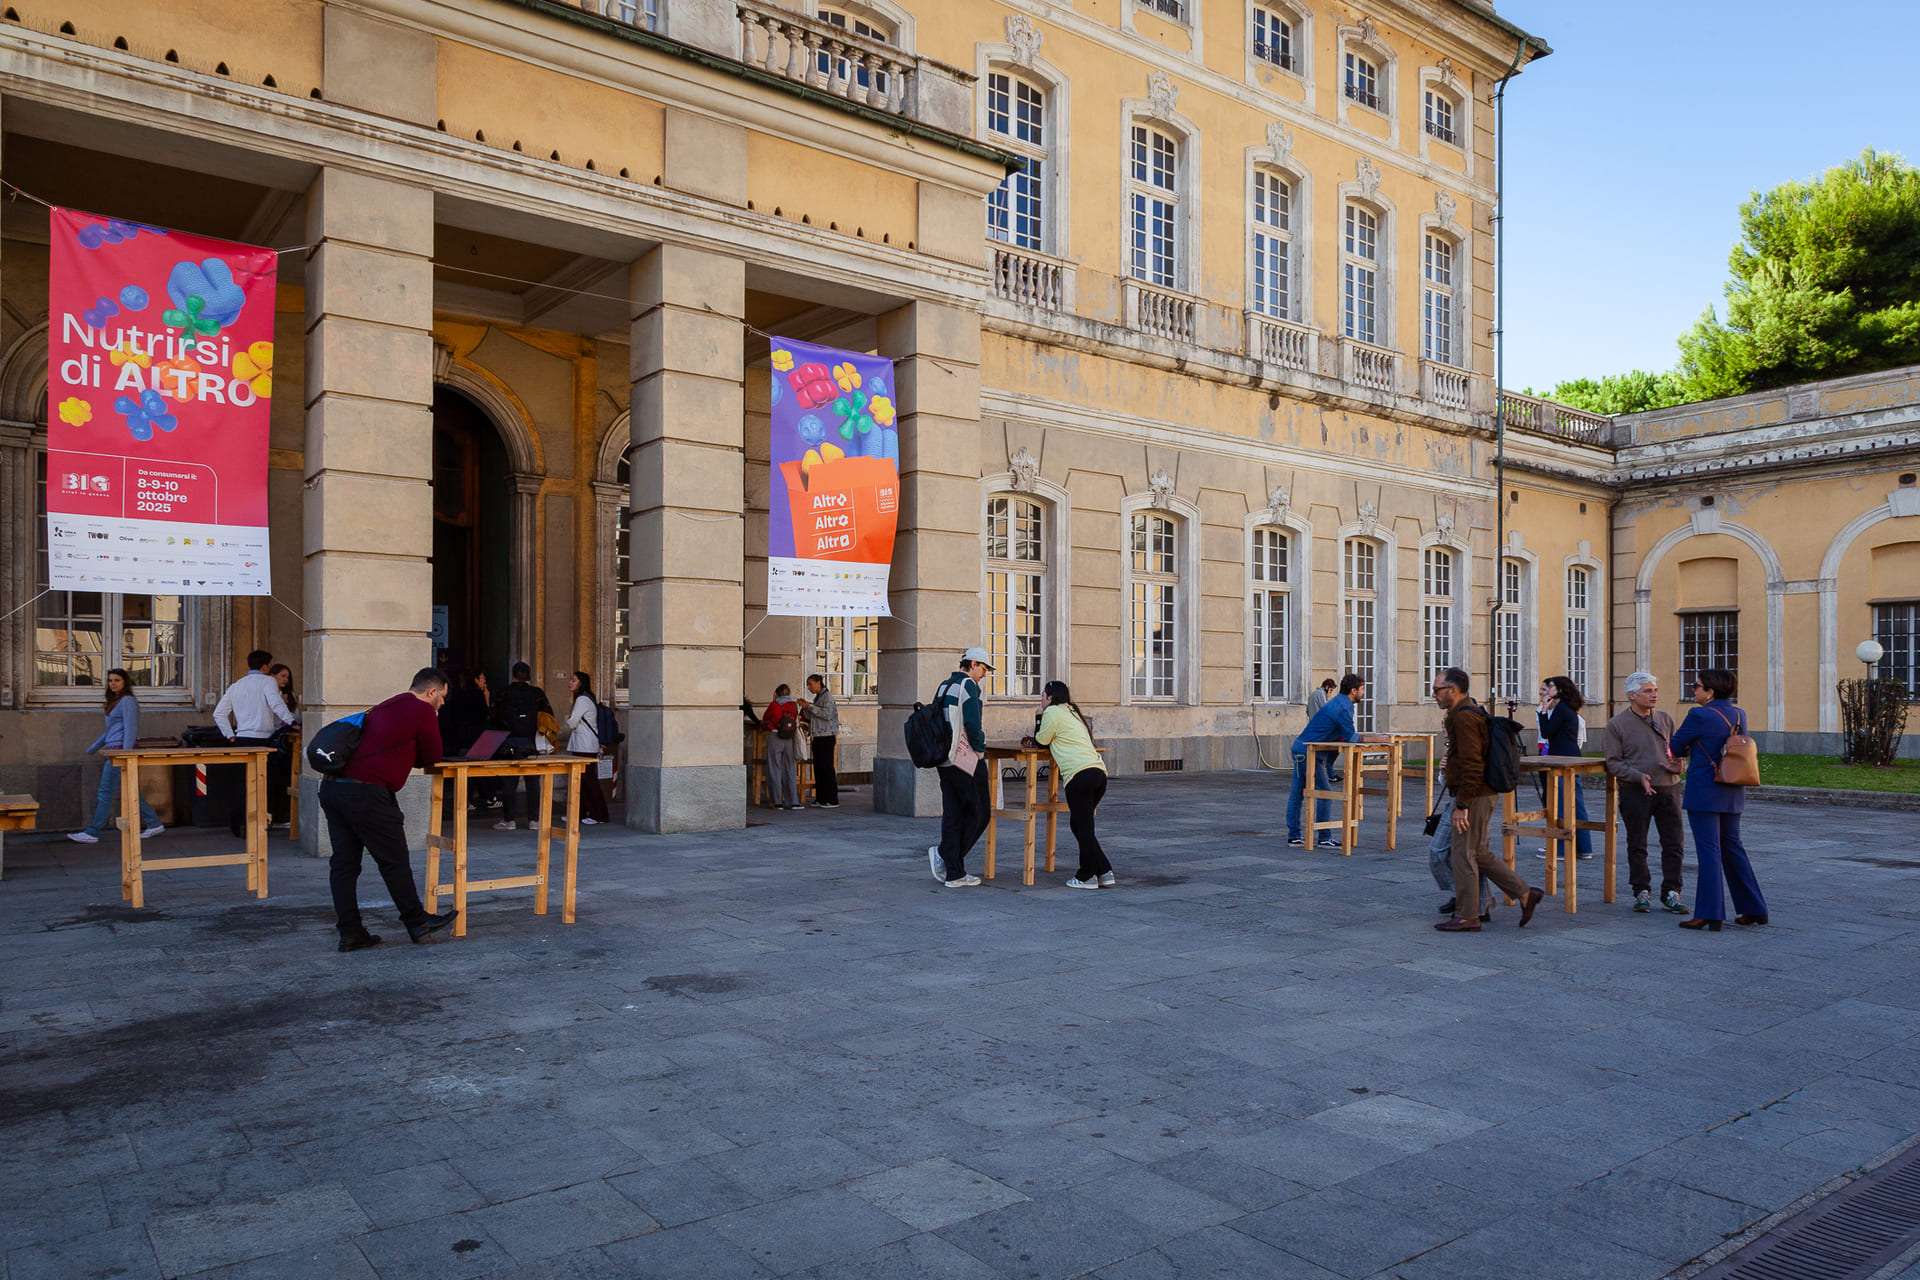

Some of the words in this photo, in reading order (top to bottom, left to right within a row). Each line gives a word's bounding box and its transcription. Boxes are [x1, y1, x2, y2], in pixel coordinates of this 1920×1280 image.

[63, 313, 230, 367] Nutrirsi
[61, 354, 101, 387] di
[114, 362, 257, 407] ALTRO
[137, 479, 179, 491] 8-9-10
[137, 491, 188, 503] ottobre
[813, 493, 847, 509] Altro
[137, 501, 172, 513] 2025
[815, 514, 849, 530] Altro
[817, 534, 850, 551] Altro
